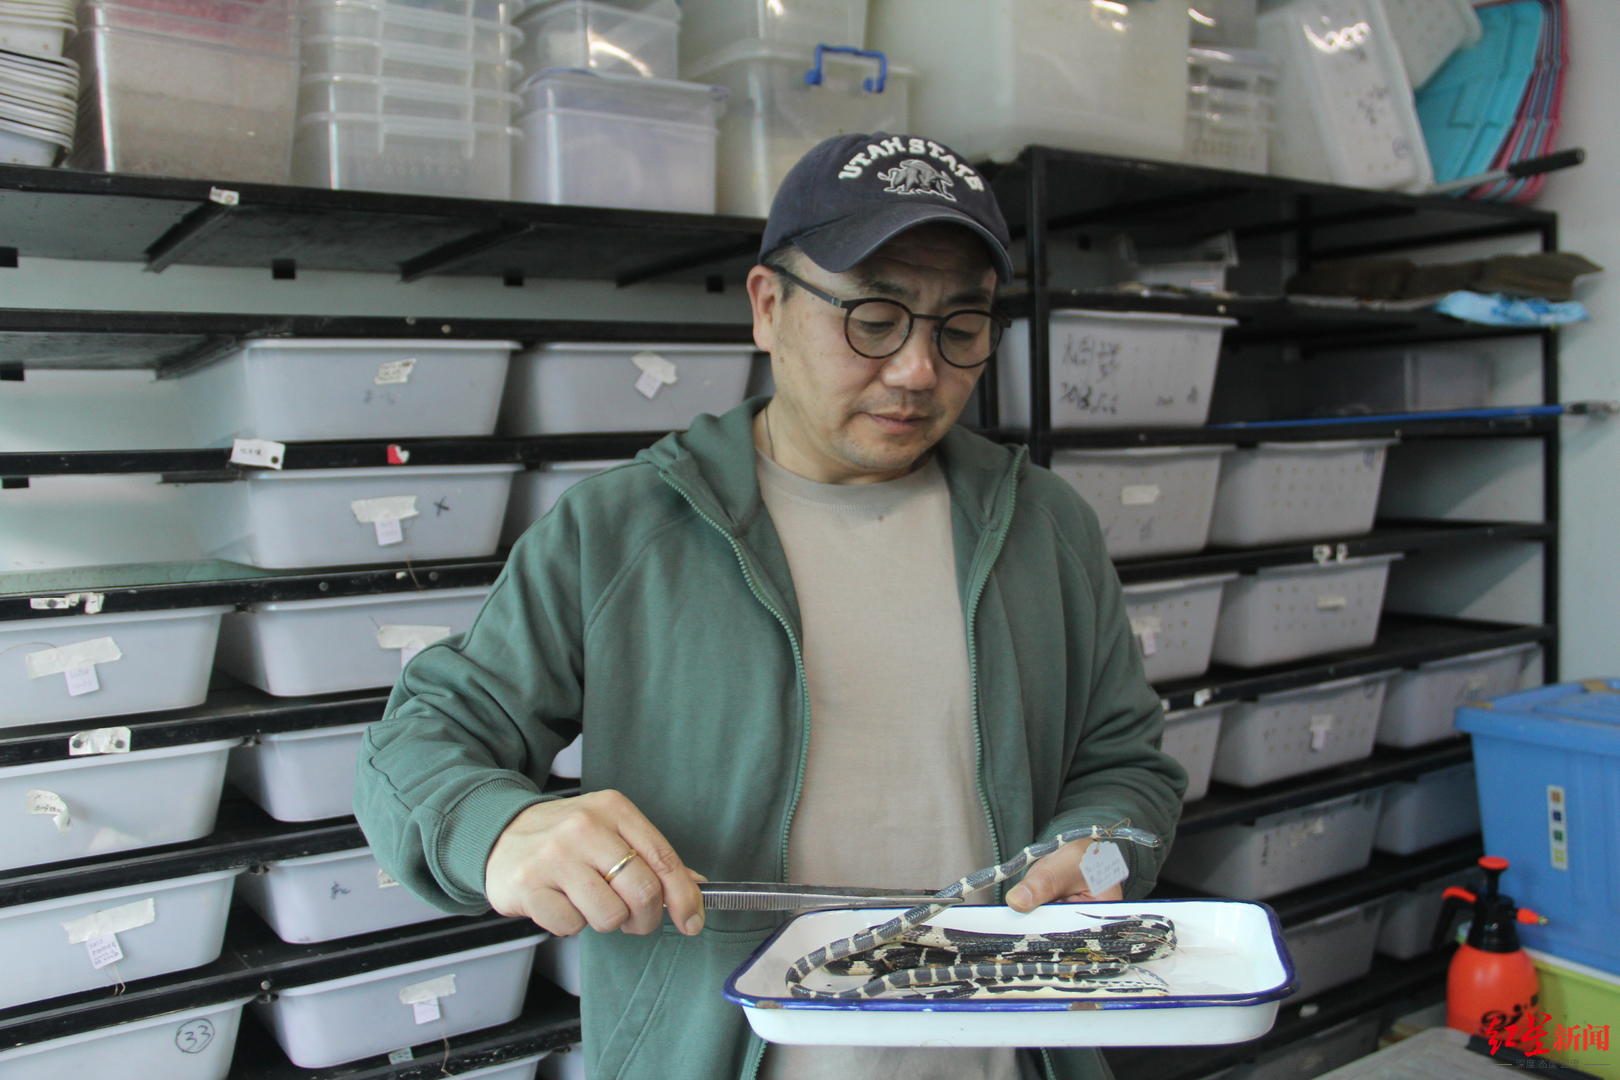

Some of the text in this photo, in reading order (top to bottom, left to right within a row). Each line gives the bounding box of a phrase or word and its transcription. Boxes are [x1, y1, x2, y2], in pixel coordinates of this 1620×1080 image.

[838, 136, 985, 192] UTAH STATE
[183, 1024, 213, 1052] 33
